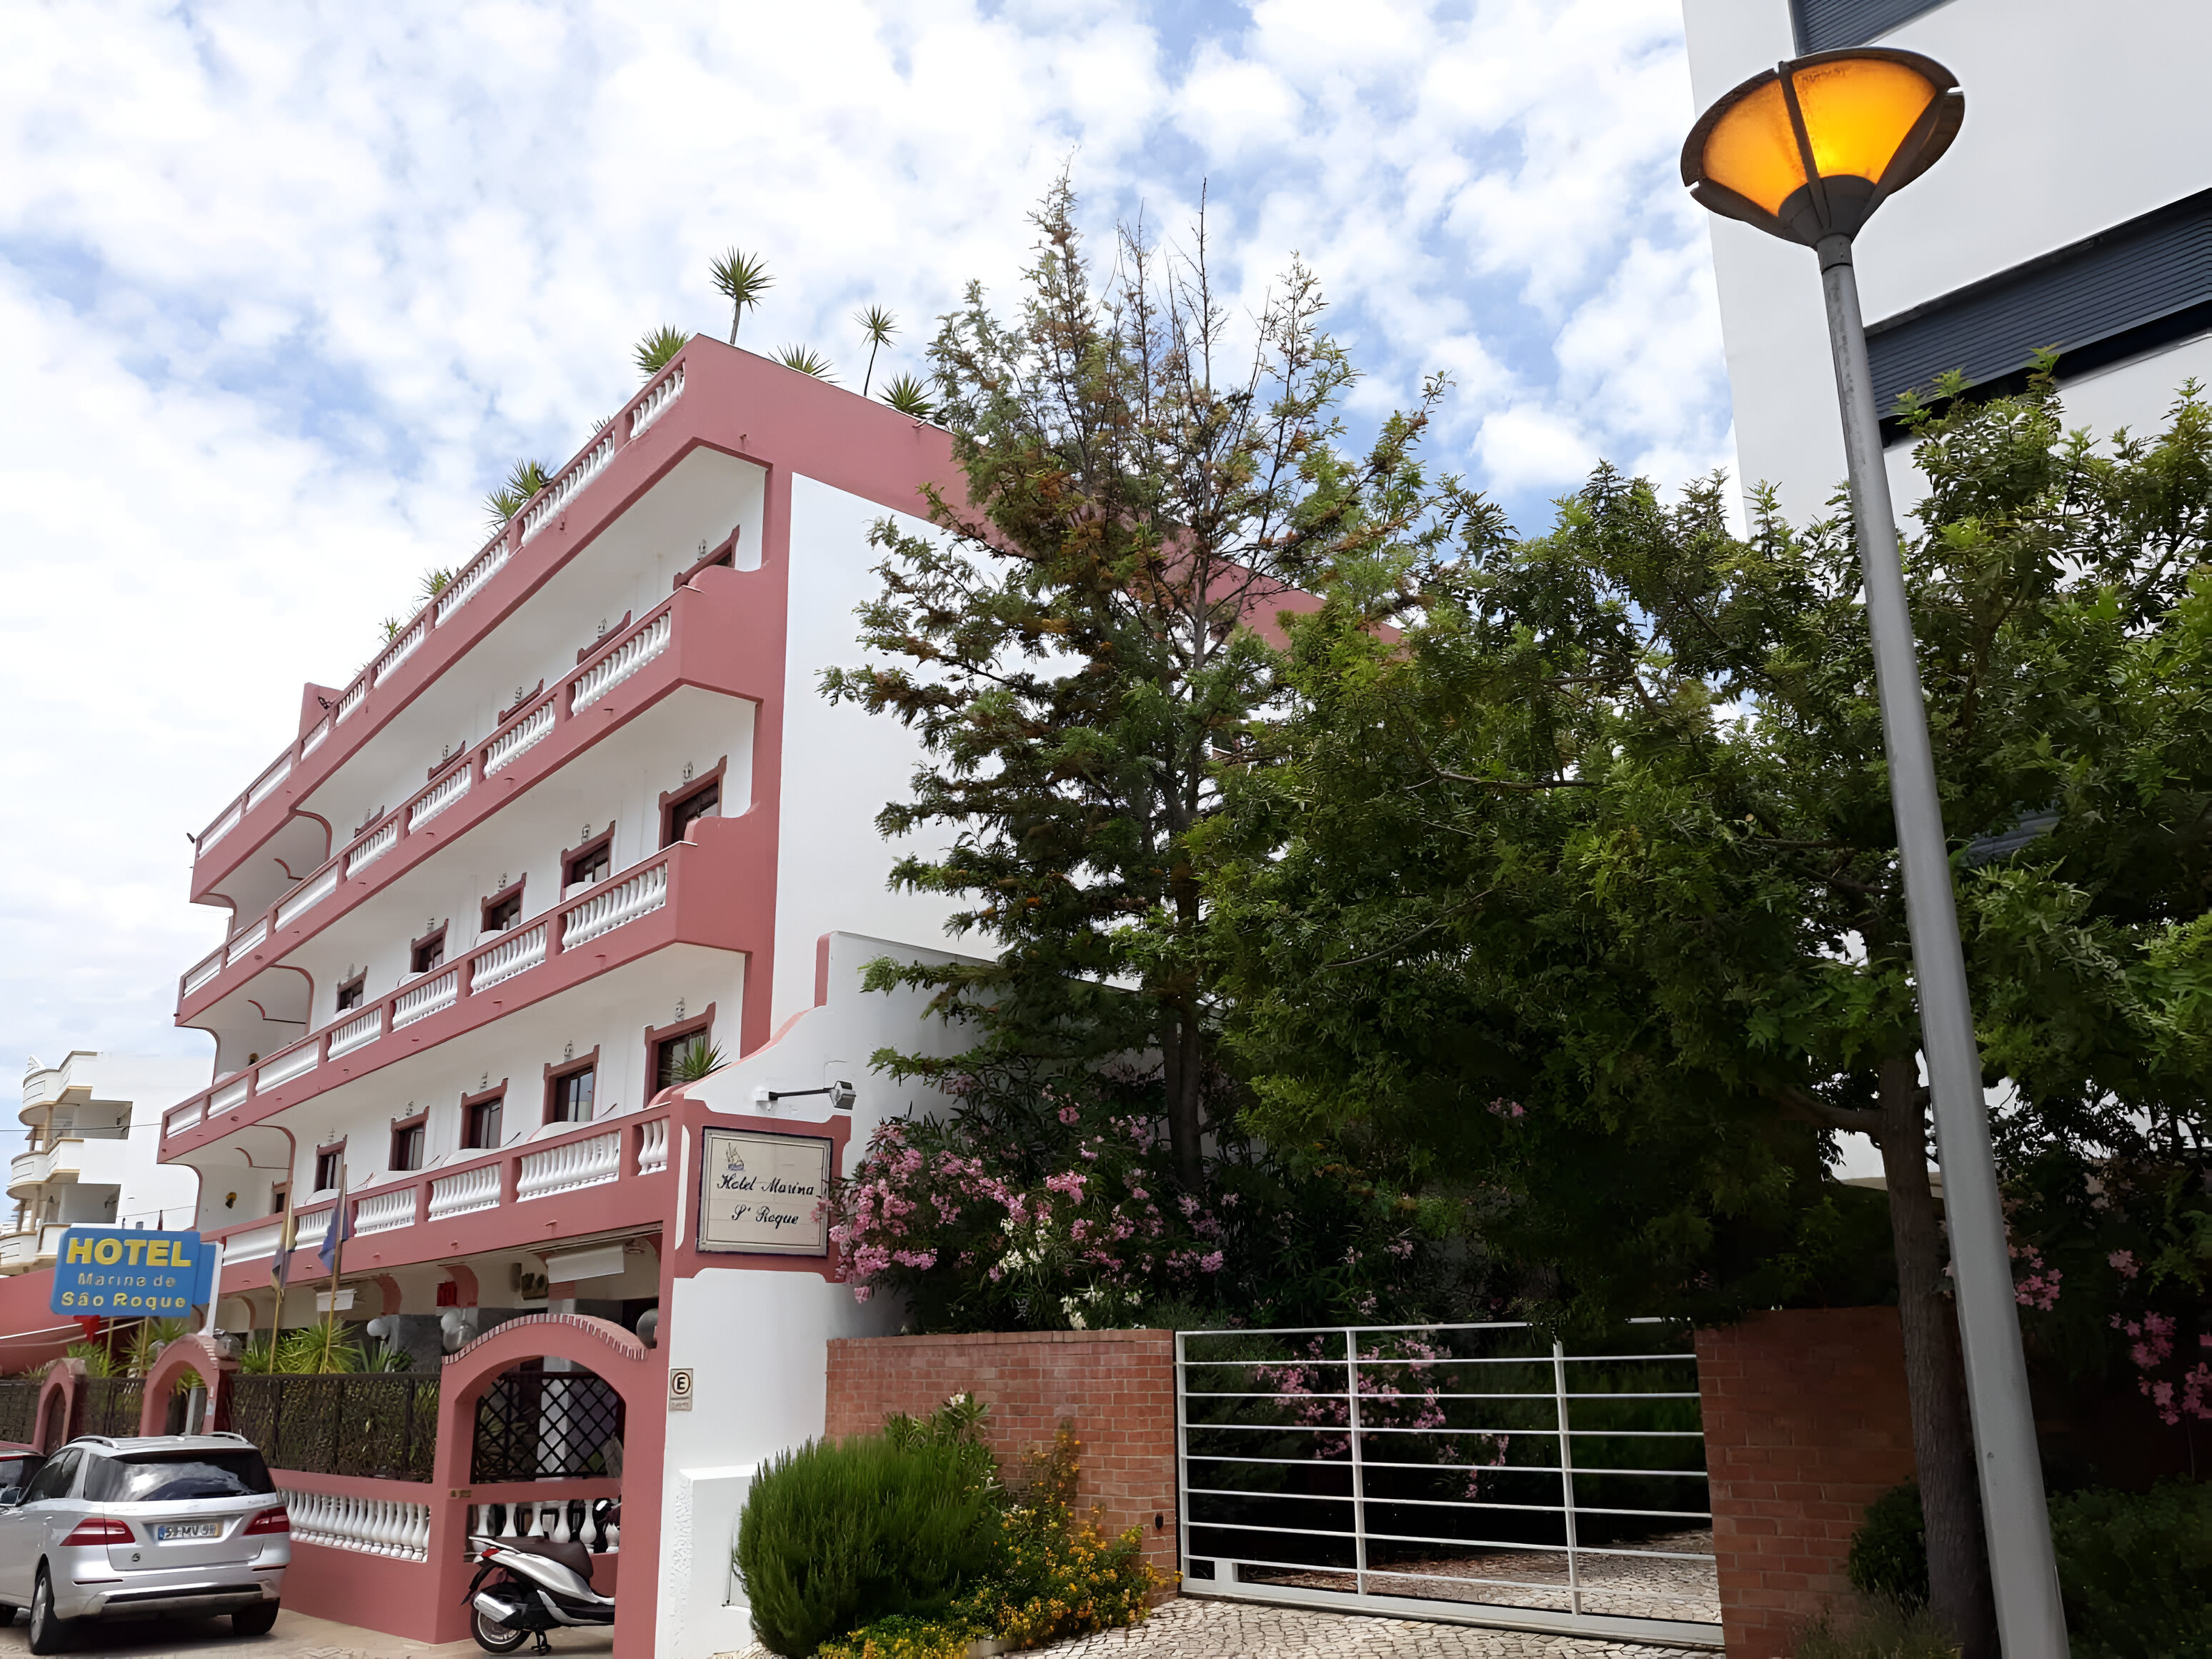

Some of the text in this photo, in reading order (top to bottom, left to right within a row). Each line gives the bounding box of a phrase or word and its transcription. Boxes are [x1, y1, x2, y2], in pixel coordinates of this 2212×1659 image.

[717, 1173, 814, 1195] Hotel Marina
[755, 1205, 799, 1230] Roque
[66, 1237, 191, 1267] HOTEL
[61, 1291, 186, 1310] São Roque
[677, 1376, 686, 1390] E
